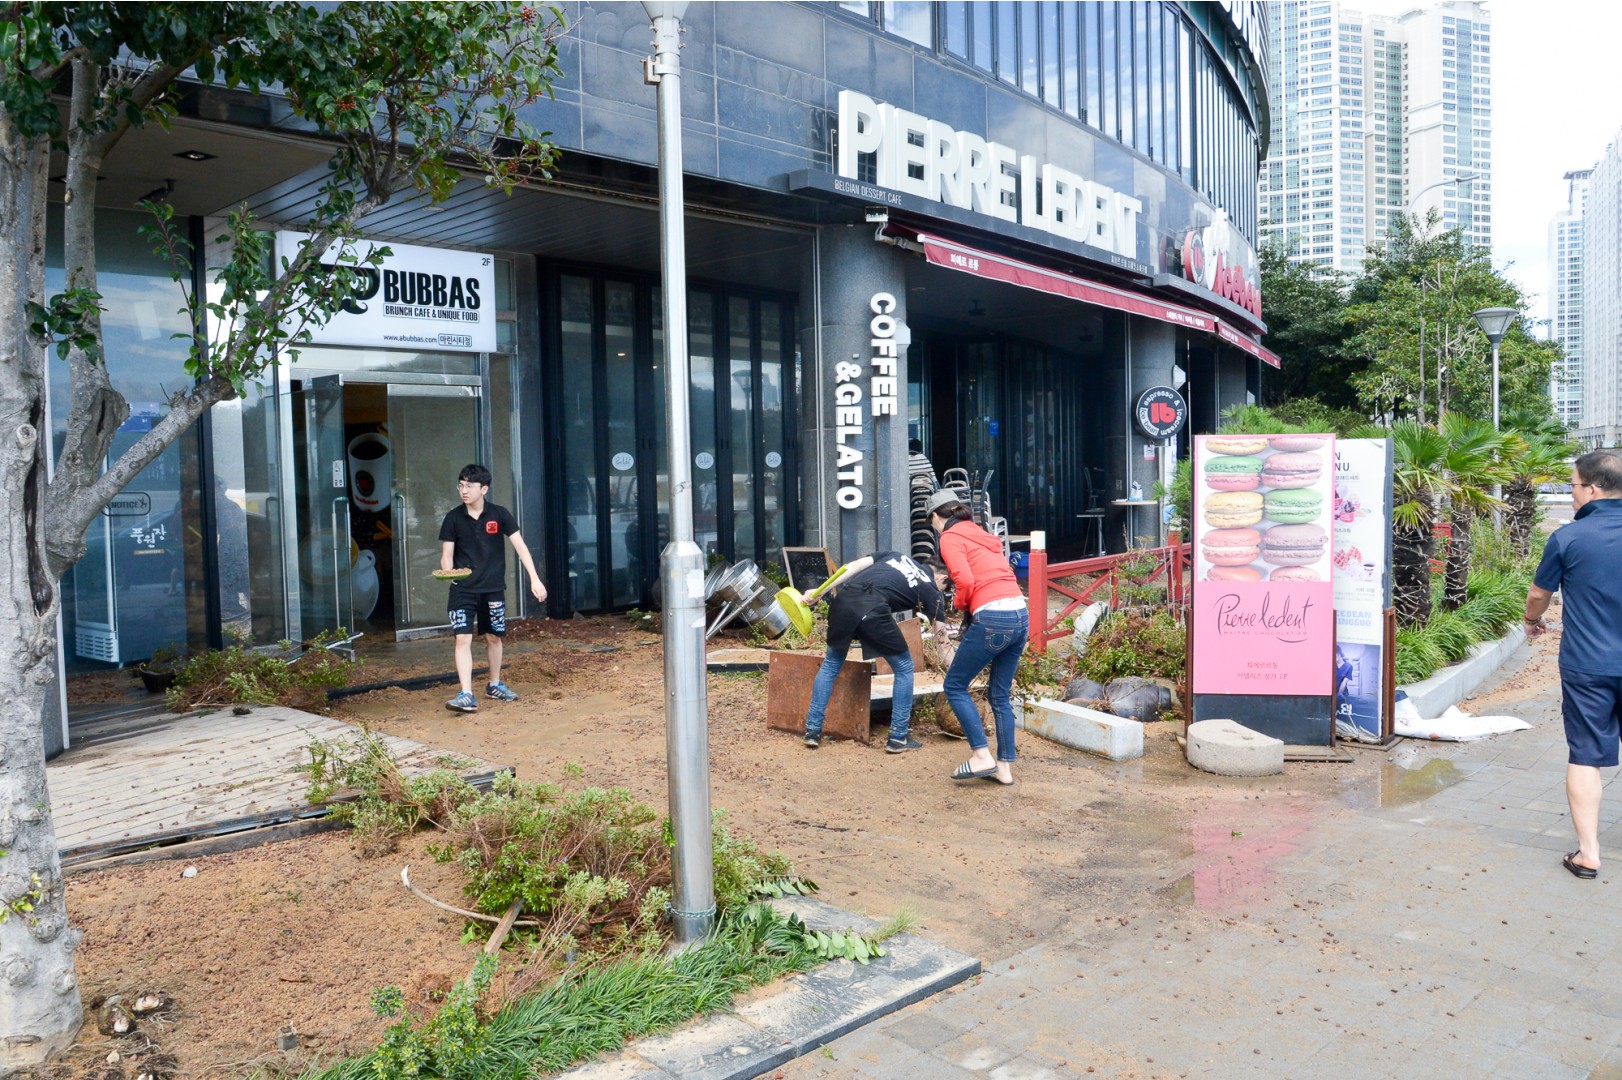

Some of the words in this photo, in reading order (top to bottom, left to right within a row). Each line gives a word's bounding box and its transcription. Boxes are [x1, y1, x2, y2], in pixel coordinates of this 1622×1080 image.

[838, 89, 1020, 223] PIERRE
[1020, 154, 1142, 260] LEDENT
[834, 179, 860, 195] BELGIAN
[860, 187, 886, 202] DESSERT
[887, 193, 902, 206] CAFE
[481, 257, 491, 267] 2F
[383, 269, 480, 309] BUBBAS
[385, 305, 413, 317] BRUNCH
[414, 308, 431, 319] CAFE
[431, 309, 437, 319] &
[437, 309, 460, 321] UNIQUE
[461, 312, 478, 322] FOOD
[383, 334, 438, 344] www.abubbas.com
[439, 336, 471, 346] 마린시티점
[869, 292, 898, 417] COFFEE
[1144, 391, 1174, 406] espresso
[1335, 462, 1350, 472] NU
[130, 524, 167, 548] 풍원장
[1213, 593, 1256, 636] Pierre
